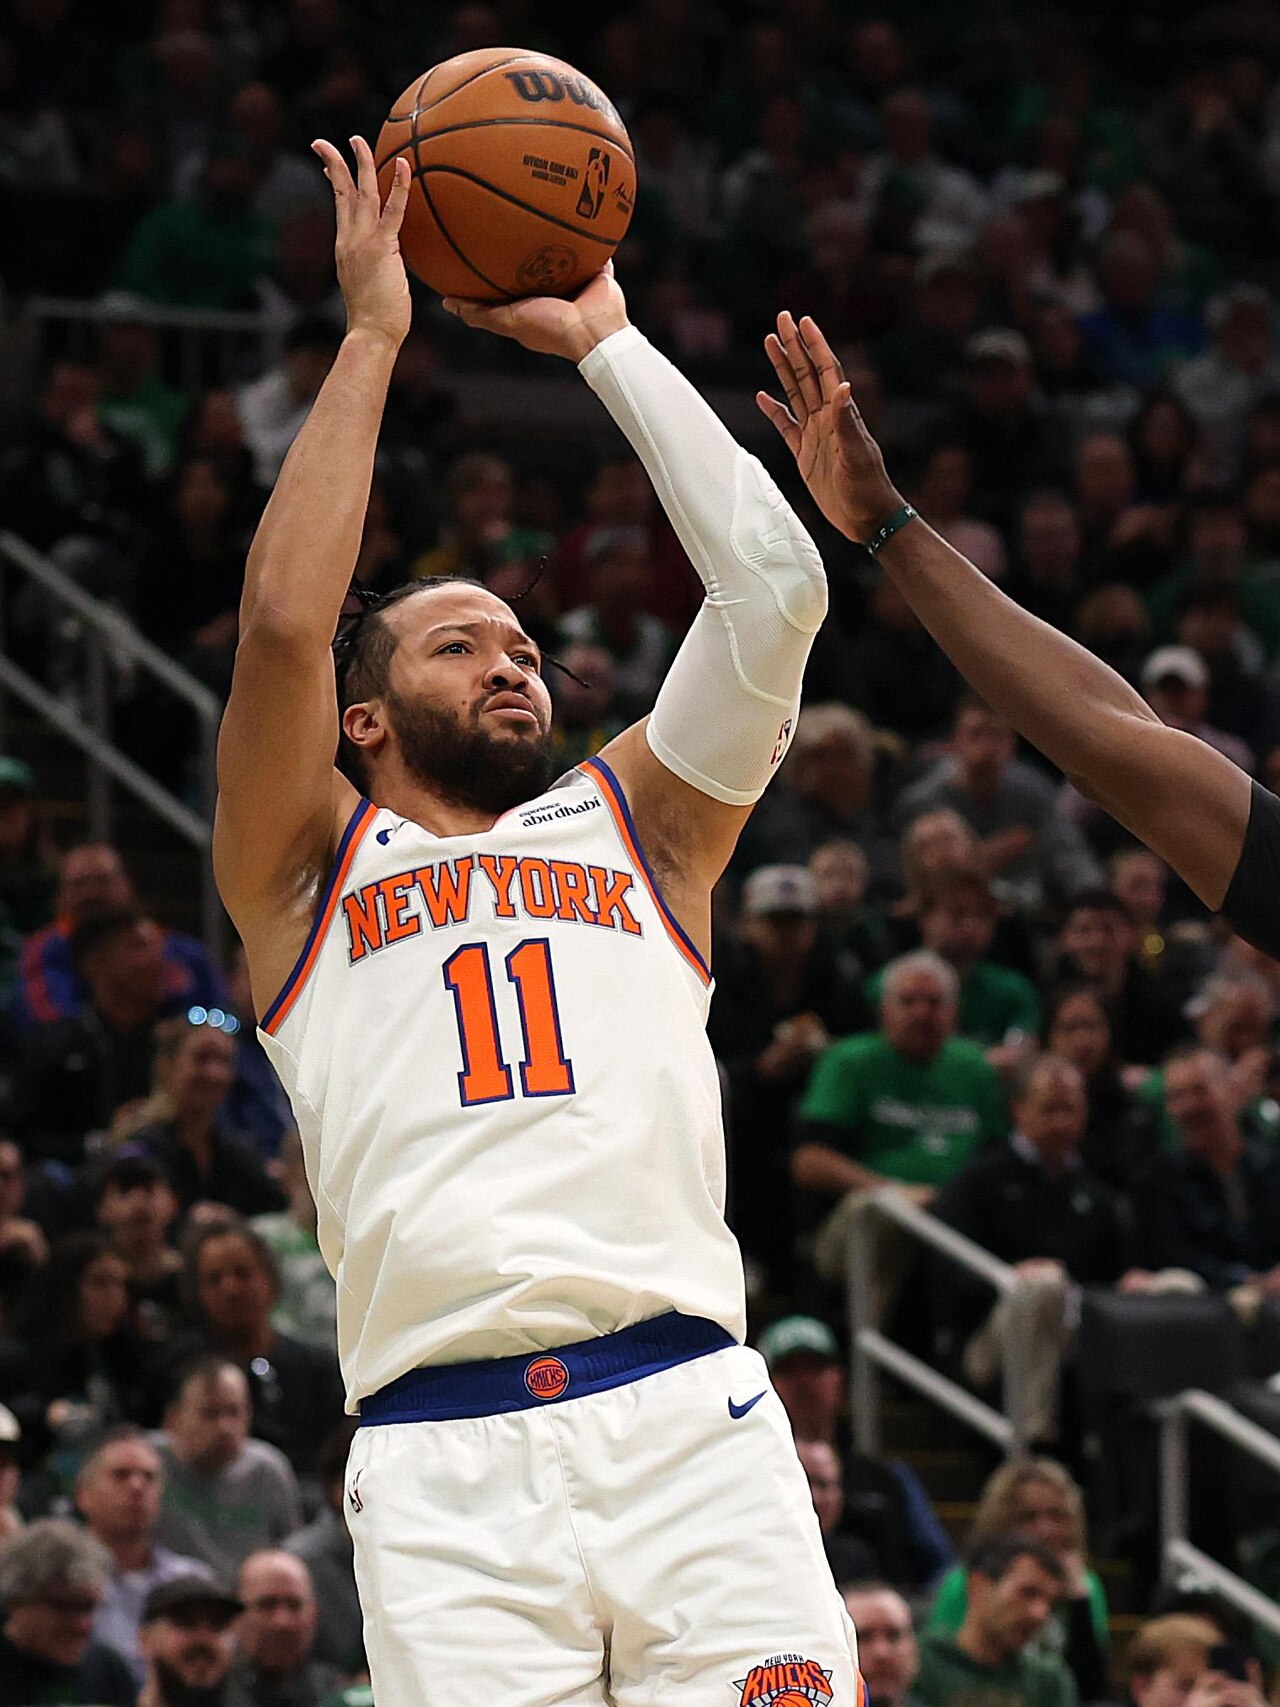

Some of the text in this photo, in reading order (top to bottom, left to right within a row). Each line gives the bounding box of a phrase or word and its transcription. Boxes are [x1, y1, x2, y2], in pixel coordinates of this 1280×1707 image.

[519, 802, 561, 817] experience
[523, 796, 602, 827] abu dhabi
[342, 854, 644, 966] NEW YORK
[442, 937, 576, 1107] 11
[764, 1653, 805, 1667] NEW YORK
[741, 1659, 833, 1707] KNICKS
